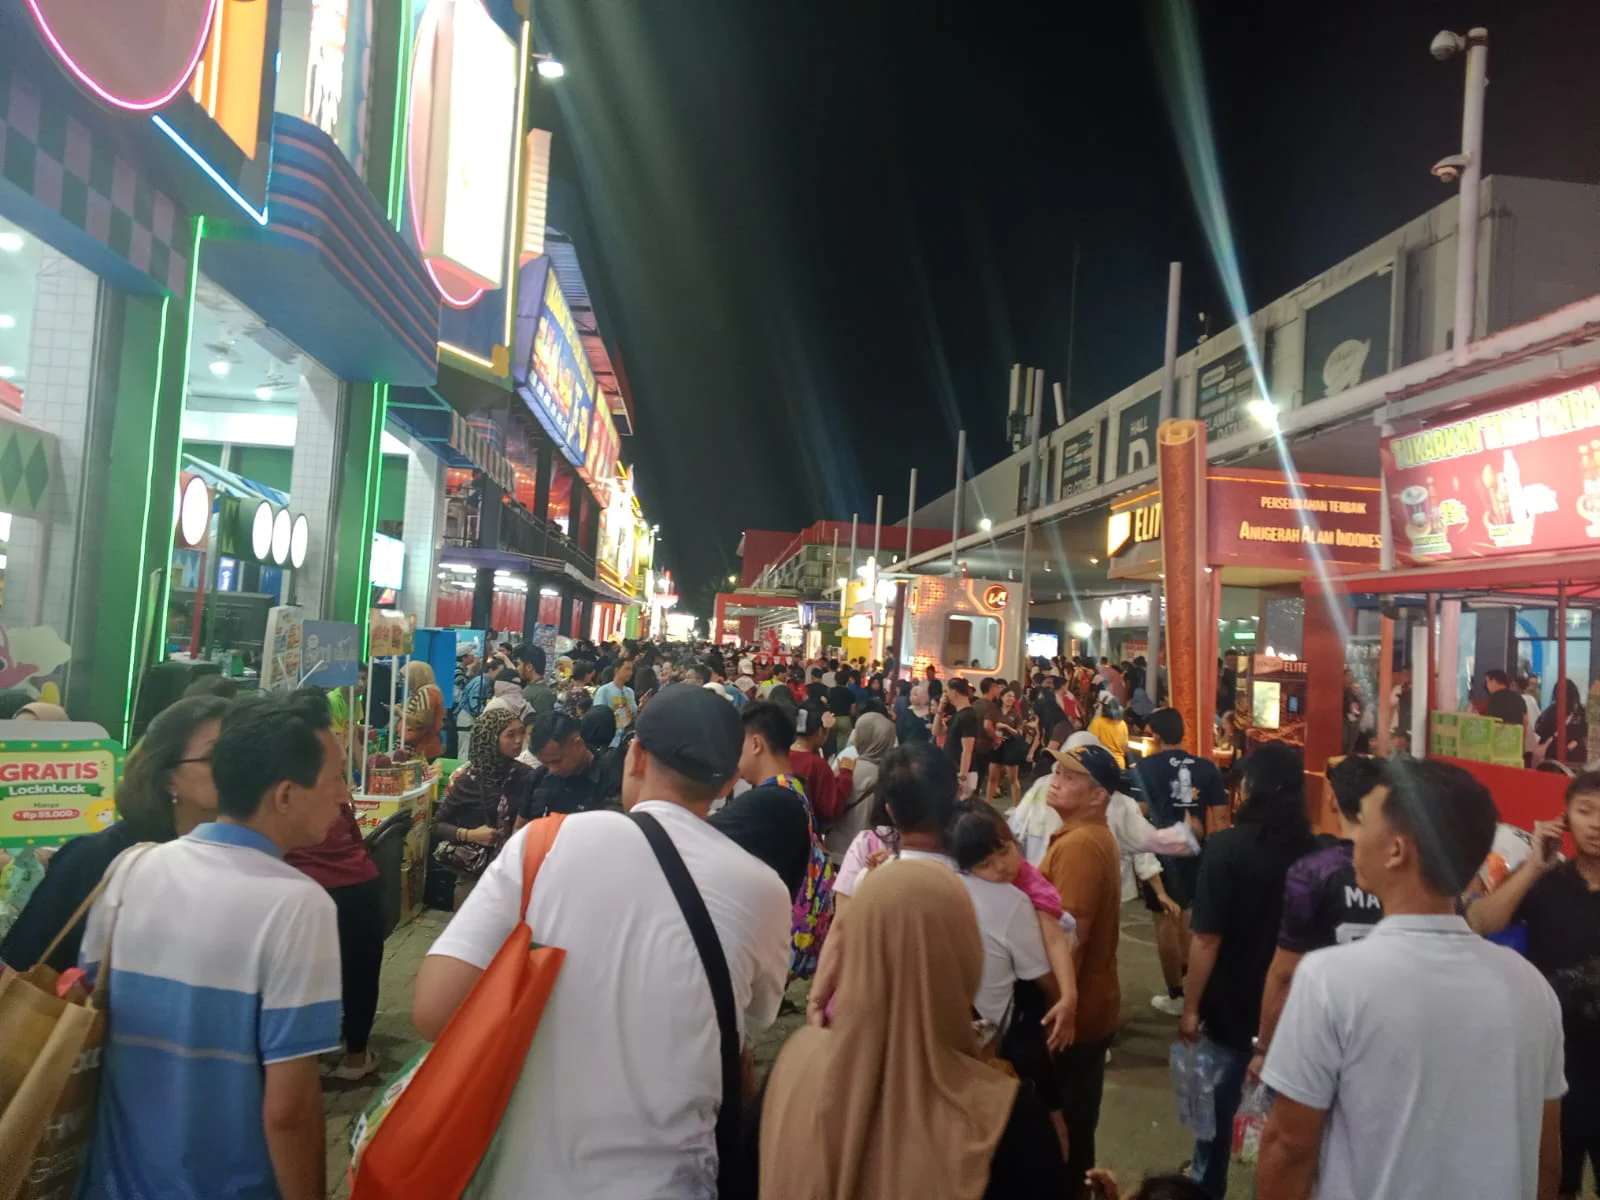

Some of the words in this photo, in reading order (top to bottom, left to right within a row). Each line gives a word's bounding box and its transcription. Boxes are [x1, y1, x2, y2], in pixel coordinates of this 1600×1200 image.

[1130, 415, 1149, 436] HALL
[1390, 418, 1484, 469] TUKARKAN
[1260, 496, 1329, 512] PERSEMBAHAN
[1329, 500, 1367, 514] TERBAIK
[1283, 661, 1308, 673] ELITE
[0, 761, 98, 782] GRATIS
[8, 783, 86, 796] LocknLock
